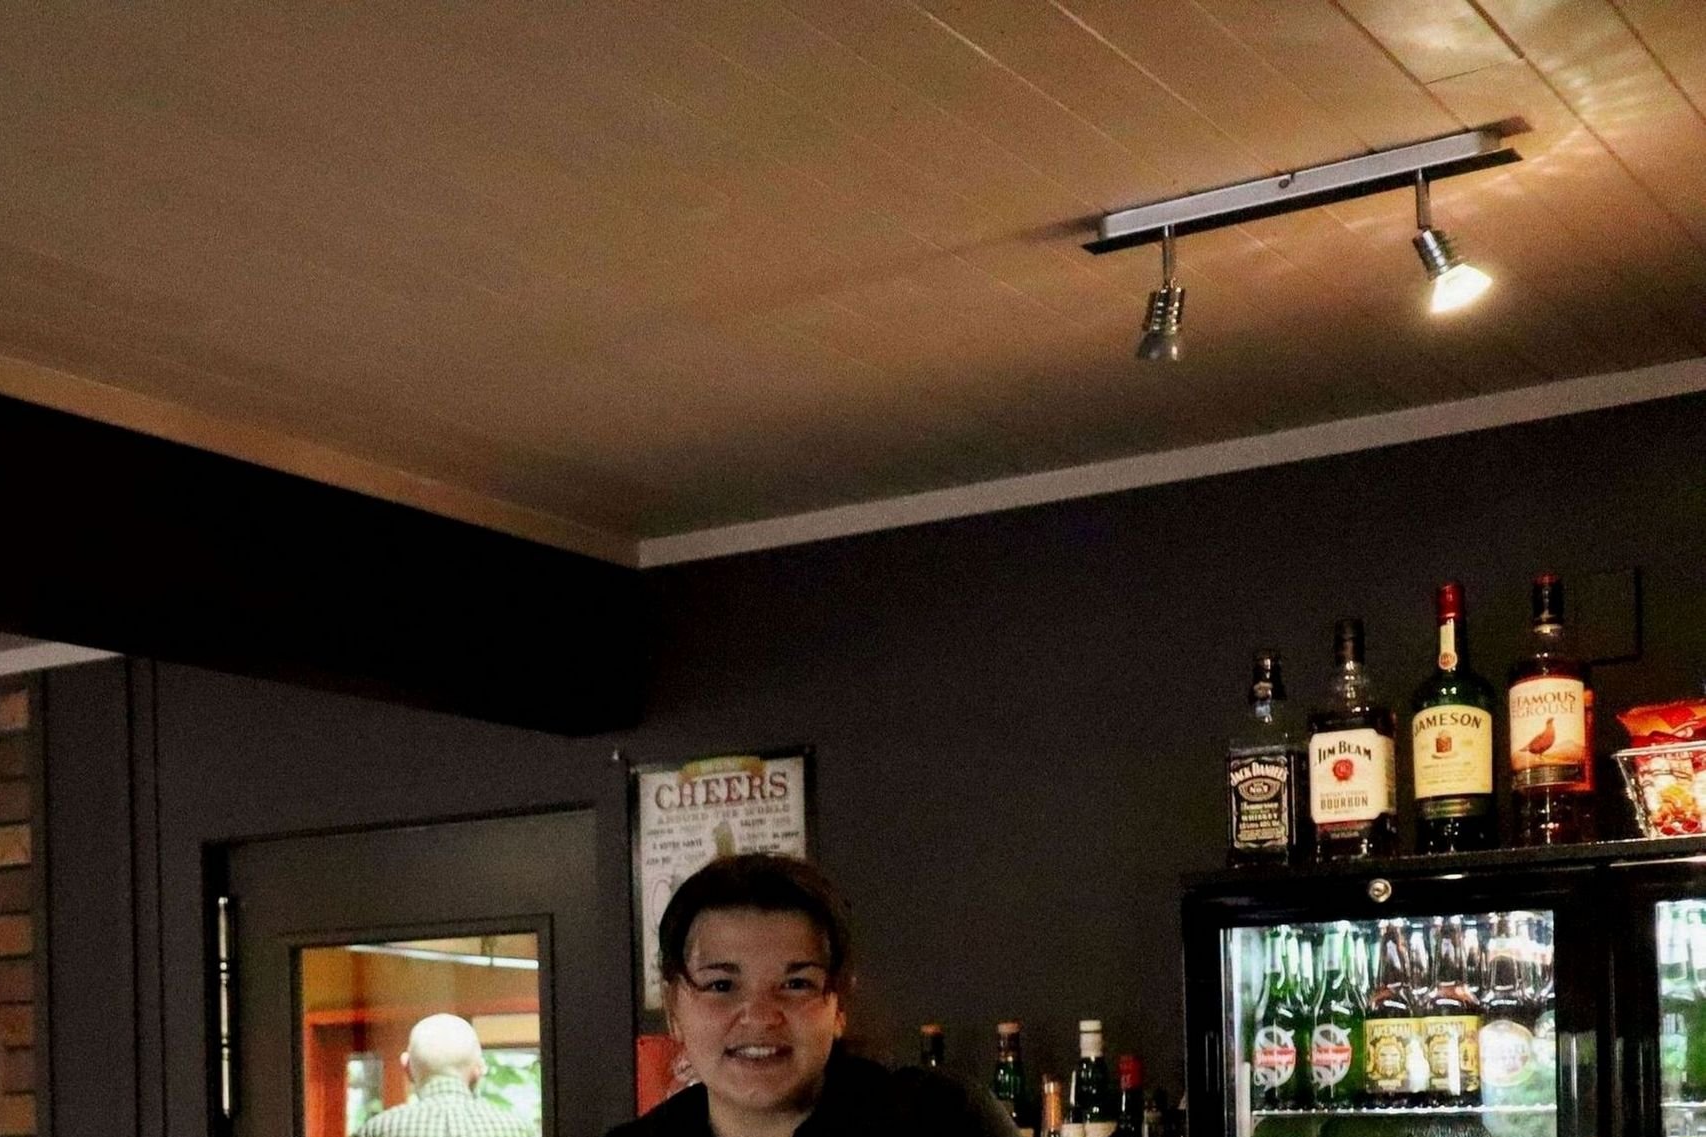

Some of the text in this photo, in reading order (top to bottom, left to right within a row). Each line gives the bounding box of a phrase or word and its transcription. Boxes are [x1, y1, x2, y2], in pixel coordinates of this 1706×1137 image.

[1516, 691, 1576, 707] FAMOUS
[1413, 712, 1482, 737] JAMESON
[1318, 740, 1372, 764] JIM BEAM
[1230, 766, 1253, 786] JACK
[655, 771, 788, 811] CHEERS
[1320, 796, 1369, 811] BOURBON
